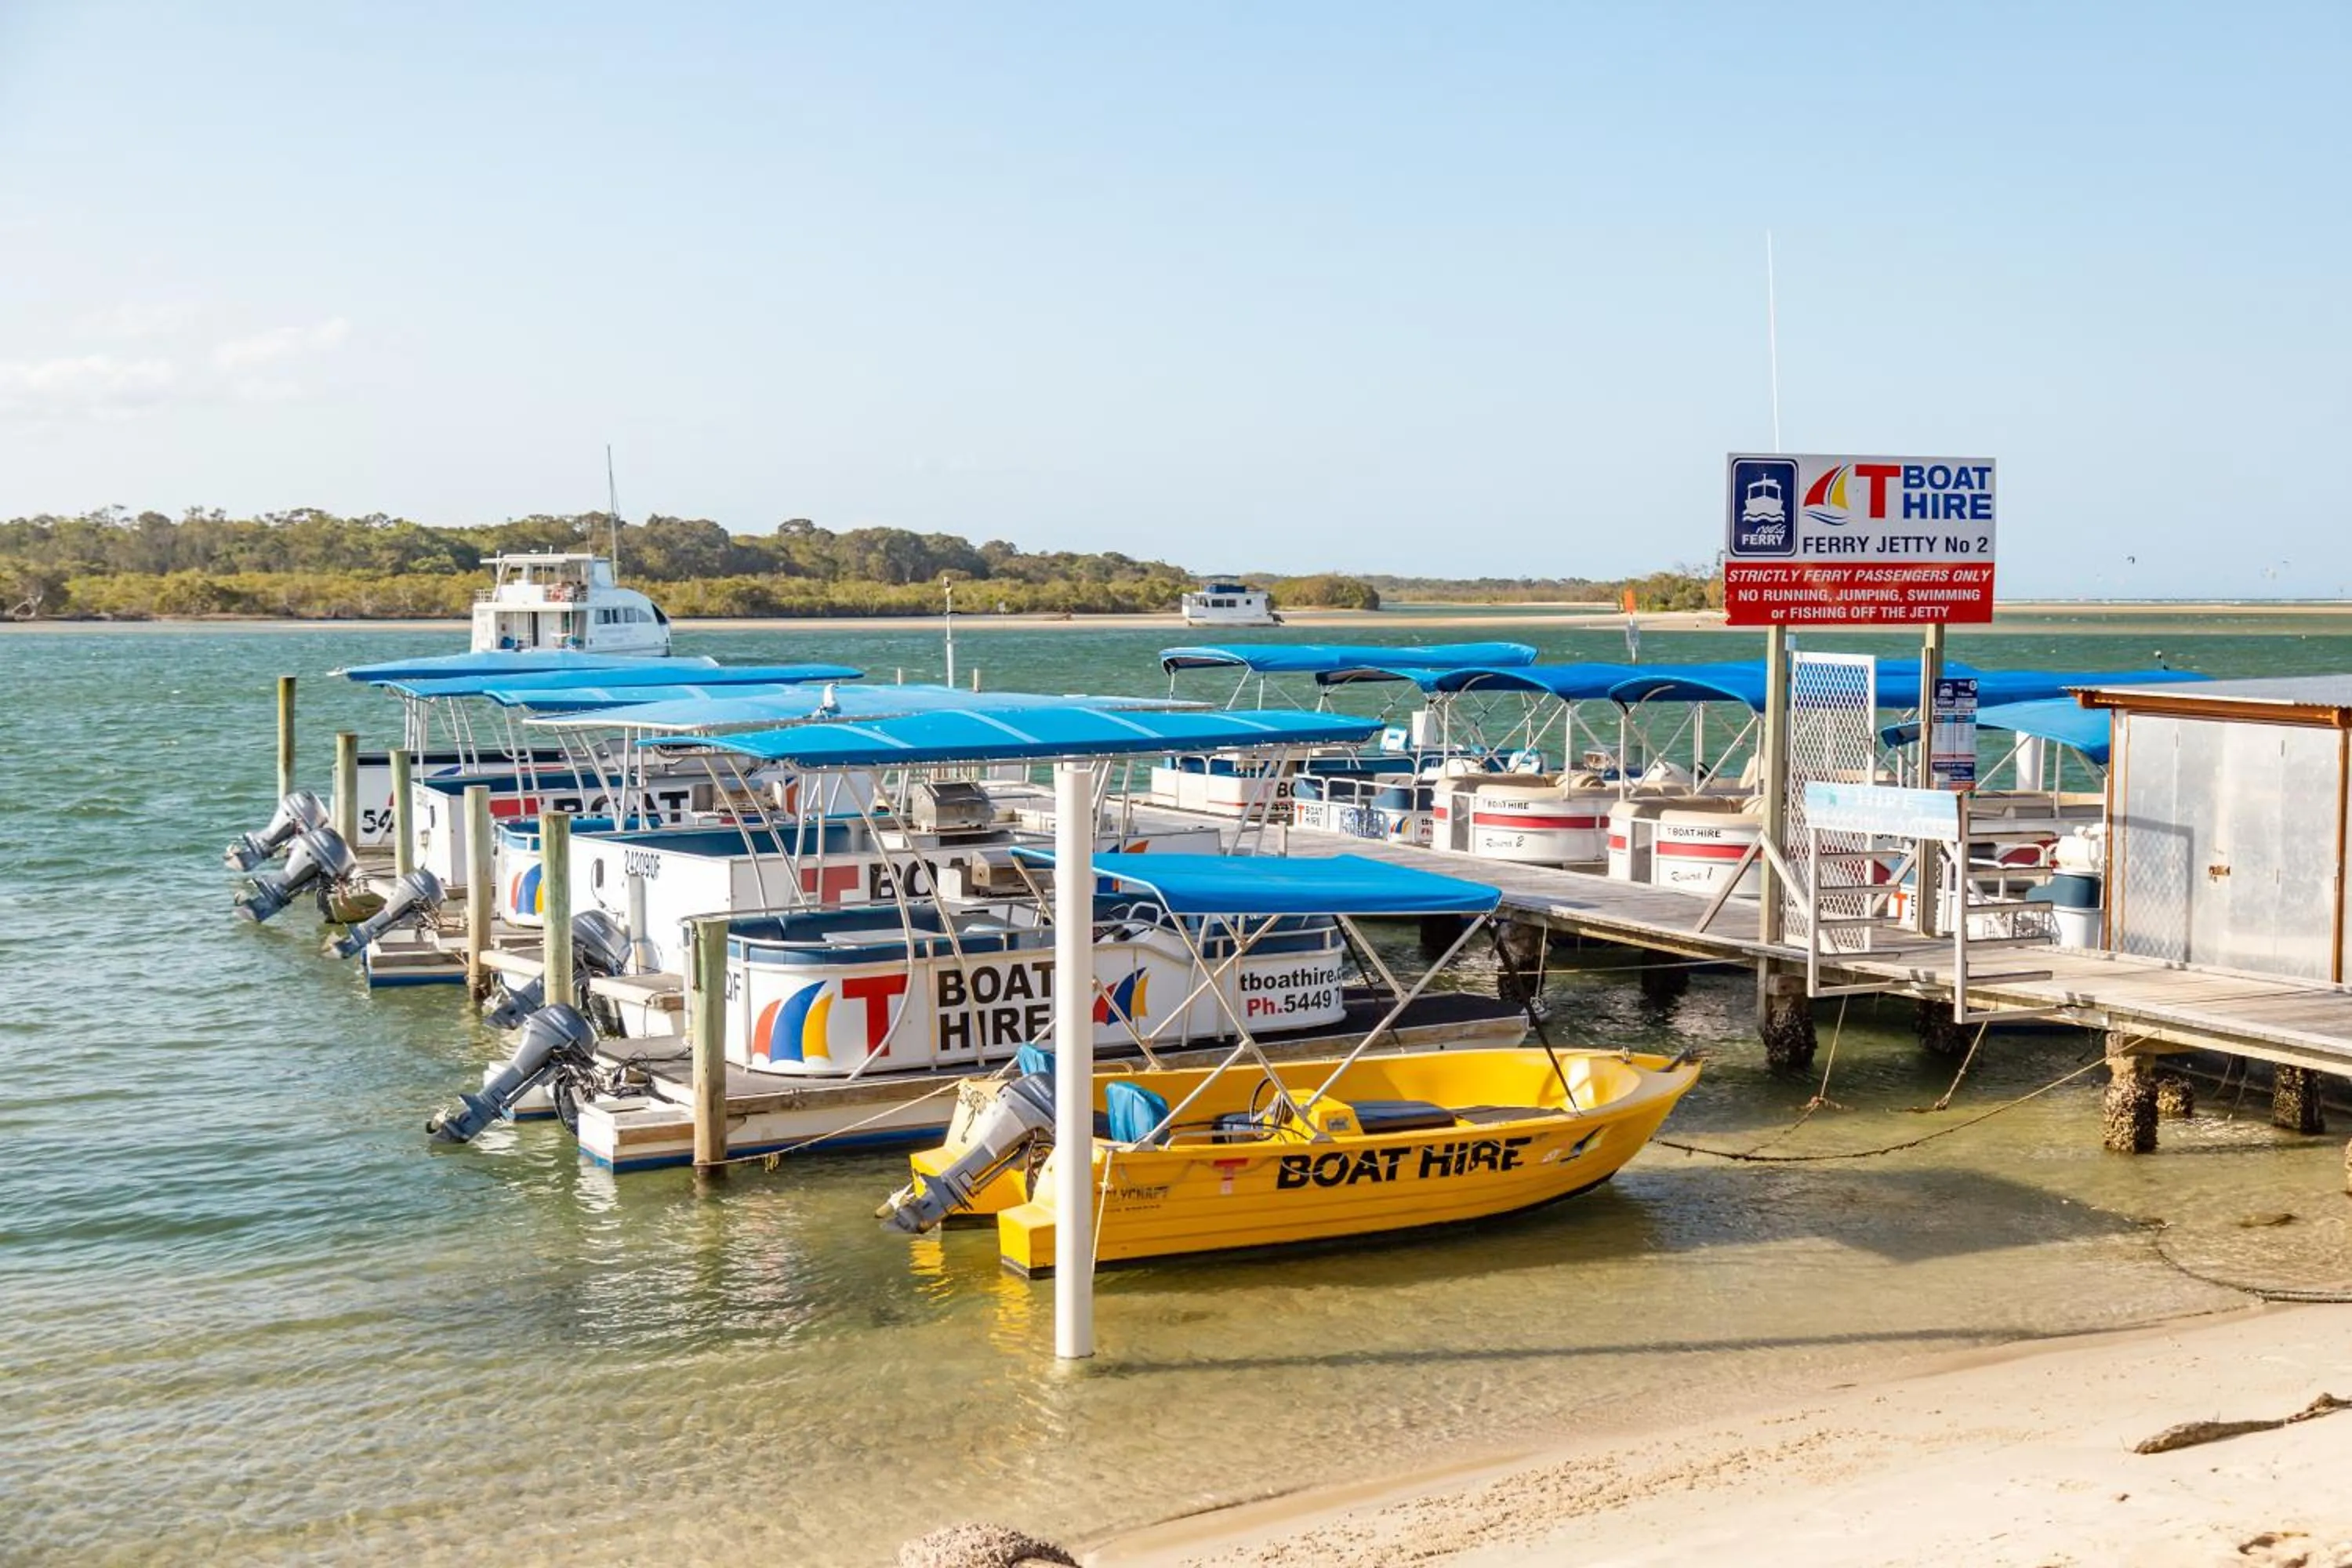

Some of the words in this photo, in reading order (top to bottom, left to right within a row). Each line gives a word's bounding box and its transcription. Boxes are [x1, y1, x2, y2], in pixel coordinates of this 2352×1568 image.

[1903, 465, 1992, 490] BOAT
[1855, 464, 1900, 518] T
[1903, 493, 1992, 520] HIRE
[1742, 533, 1784, 546] FERRY
[1803, 536, 1870, 553] FERRY
[1876, 536, 1936, 554] JETTY
[1945, 537, 1969, 553] No
[1977, 537, 1988, 553] 2
[1728, 569, 1802, 583] STRICTLY
[1803, 569, 1852, 583] FERRY
[1855, 569, 1949, 583] PASSENGERS
[1952, 569, 1991, 583] ONLY
[1737, 590, 1759, 601] NO
[1763, 590, 1833, 603] RUNNING,
[1836, 590, 1904, 603] JUMPING,
[1907, 589, 1980, 601] SWIMMING
[1772, 608, 1784, 619] or
[1790, 608, 1846, 619] FISHING
[1851, 607, 1876, 619] OFF
[1881, 607, 1907, 619] THE
[1910, 607, 1949, 619] JETTY
[1672, 827, 1695, 837] BOAT
[1697, 829, 1721, 838] HIRE
[938, 961, 1055, 1007] BOAT
[842, 974, 910, 1057] T
[940, 1004, 1051, 1051] HIRE
[1276, 1147, 1411, 1189] BOAT
[1417, 1135, 1534, 1179] HIRE
